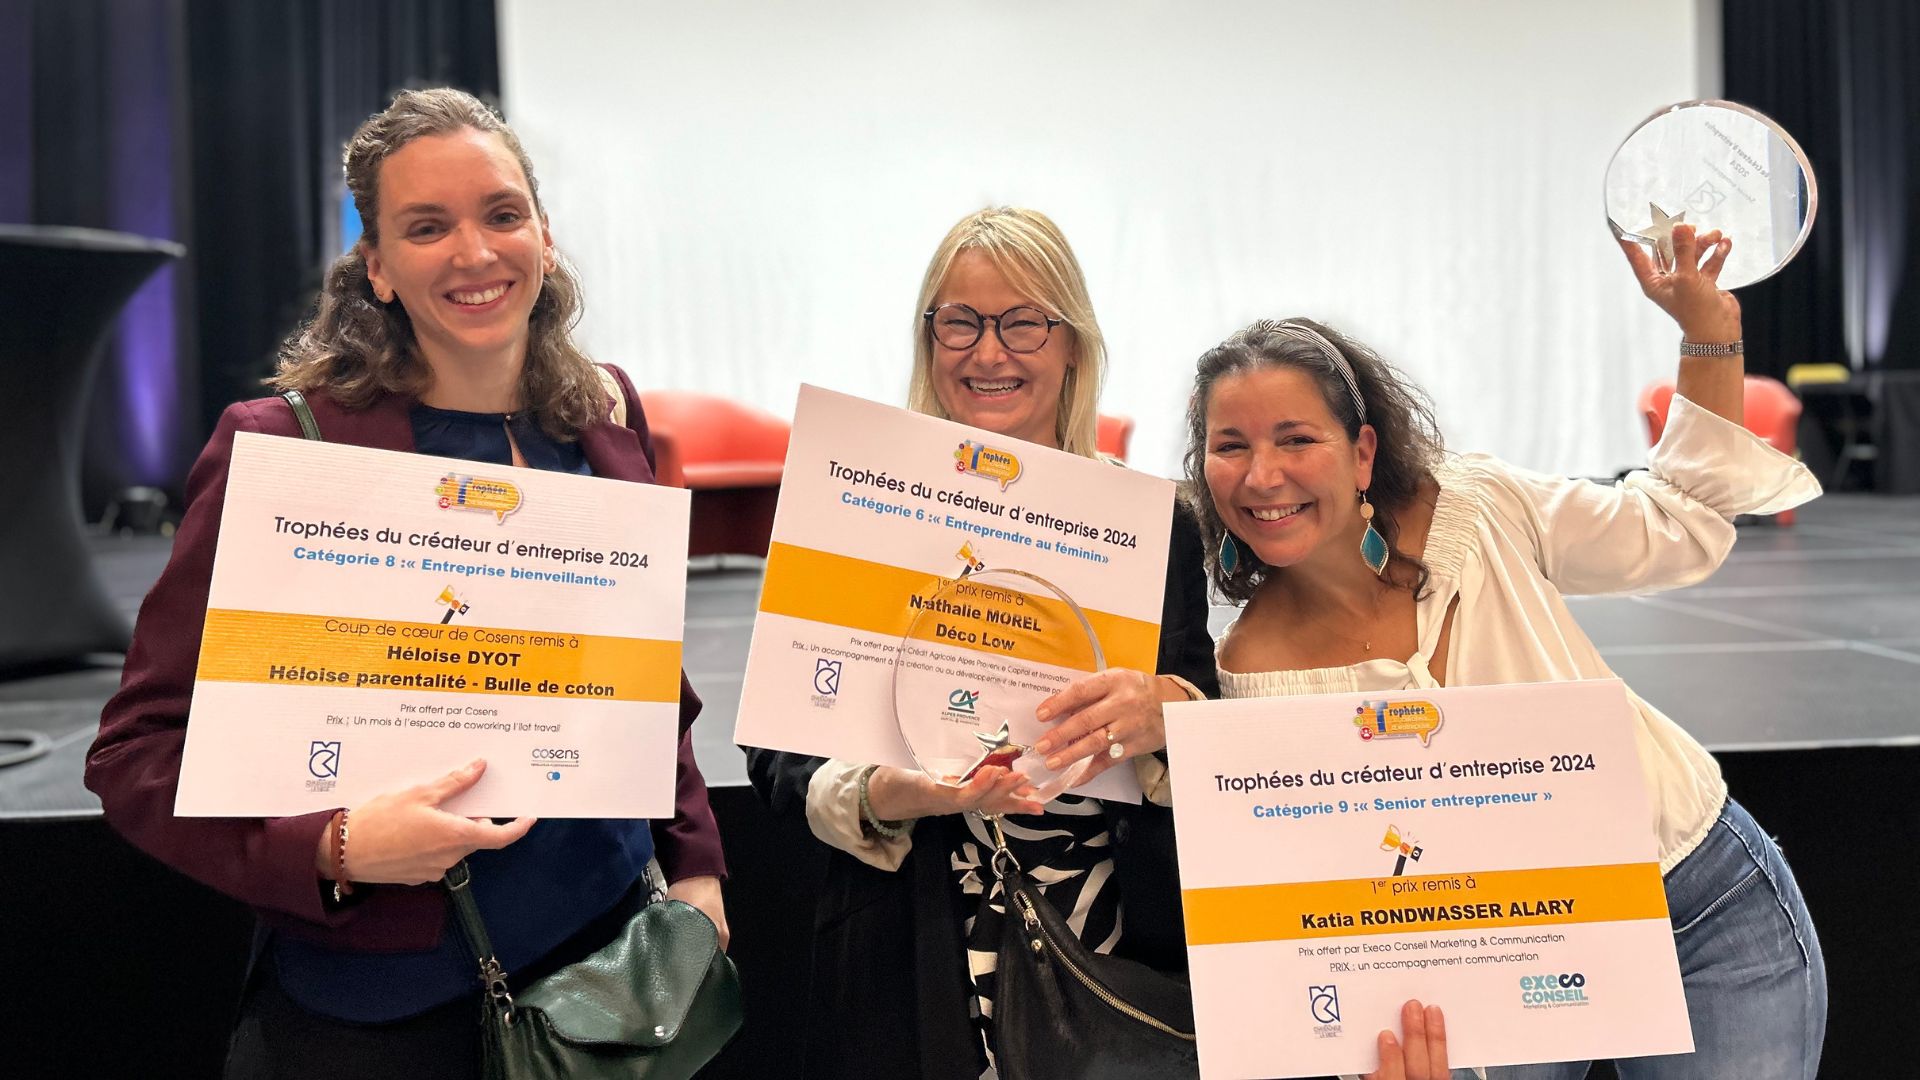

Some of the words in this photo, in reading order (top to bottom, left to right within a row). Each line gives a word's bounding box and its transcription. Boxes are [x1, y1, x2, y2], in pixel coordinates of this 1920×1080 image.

[829, 460, 906, 493] Trophées
[910, 482, 932, 499] du
[937, 490, 1005, 517] créateur
[1009, 506, 1099, 540] d'entreprise
[1103, 528, 1137, 549] 2024
[841, 491, 912, 518] Catégorie
[915, 509, 925, 520] 6
[945, 515, 1032, 541] Entreprendre
[1035, 539, 1051, 550] au
[1055, 541, 1109, 564] féminin»
[274, 516, 369, 541] Trophées
[376, 528, 401, 544] du
[408, 532, 491, 553] créateur
[497, 540, 604, 564] d'entreprise
[609, 551, 649, 569] 2024
[293, 547, 379, 565] Catégorie
[385, 555, 396, 567] 8
[421, 559, 505, 577] Entreprise
[510, 567, 616, 588] bienveillante»
[955, 583, 977, 596] prix
[981, 587, 1012, 603] remis
[1015, 591, 1025, 606] à
[910, 594, 982, 620] Nathalie
[986, 609, 1042, 632] MOREL
[325, 619, 370, 637] Coup
[375, 624, 397, 636] de
[401, 627, 444, 640] cœur
[448, 628, 469, 642] de
[473, 629, 525, 645] Cosens
[529, 635, 565, 648] remis
[569, 636, 579, 649] à
[936, 623, 977, 643] Déco
[981, 632, 1016, 651] Low
[387, 645, 461, 664] Héloise
[467, 650, 521, 667] DYOT
[792, 640, 804, 650] Prix
[810, 644, 820, 652] Un
[821, 647, 887, 666] accompagnement
[887, 657, 894, 666] à
[906, 661, 934, 671] création
[850, 637, 862, 646] Prix
[863, 640, 882, 650] offert
[882, 645, 895, 653] par
[907, 646, 928, 657] Crédit
[929, 650, 957, 663] Agricole
[958, 655, 976, 666] Alpes
[1007, 665, 1031, 677] Capital
[1039, 672, 1071, 684] Innovation
[269, 665, 350, 683] Héloise
[356, 671, 467, 689] parentalité
[485, 676, 531, 693] Bulle
[537, 680, 559, 694] de
[564, 682, 615, 697] coton
[326, 715, 344, 725] Prix
[353, 716, 368, 726] Un
[369, 718, 392, 727] mois
[394, 717, 402, 727] à
[404, 718, 446, 729] l'espace
[448, 720, 462, 729] de
[463, 721, 511, 733] coworking
[400, 703, 417, 713] Prix
[418, 705, 444, 715] offert
[446, 707, 463, 716] par
[465, 706, 498, 717] Cosens
[531, 748, 580, 760] cosens
[1215, 770, 1304, 794] Trophées
[1309, 769, 1335, 787] du
[1341, 765, 1423, 785] créateur
[1429, 757, 1545, 779] d'entreprise
[1549, 753, 1596, 773] 2024
[1253, 801, 1334, 819] Catégorie
[1338, 800, 1349, 813] 9
[1373, 796, 1427, 811] Senior
[1431, 790, 1538, 808] entrepreneur
[1371, 880, 1387, 895] 1er
[1392, 881, 1419, 896] prix
[1423, 877, 1461, 892] remis
[1465, 875, 1477, 889] à
[1301, 912, 1355, 930] Katia
[1360, 903, 1504, 926] RONDWASSER
[1509, 899, 1575, 917] ALARY
[1298, 946, 1315, 957] Prix
[1316, 945, 1342, 956] offert
[1344, 945, 1360, 955] par
[1362, 942, 1392, 954] Execo
[1393, 940, 1428, 951] Conseil
[1430, 937, 1478, 950] Marketing
[1479, 936, 1488, 947] &
[1489, 933, 1566, 946] Communication
[1357, 961, 1371, 971] un
[1372, 956, 1463, 970] accompagnement
[1465, 952, 1540, 965] communication
[1521, 988, 1589, 1004] CONSEIL
